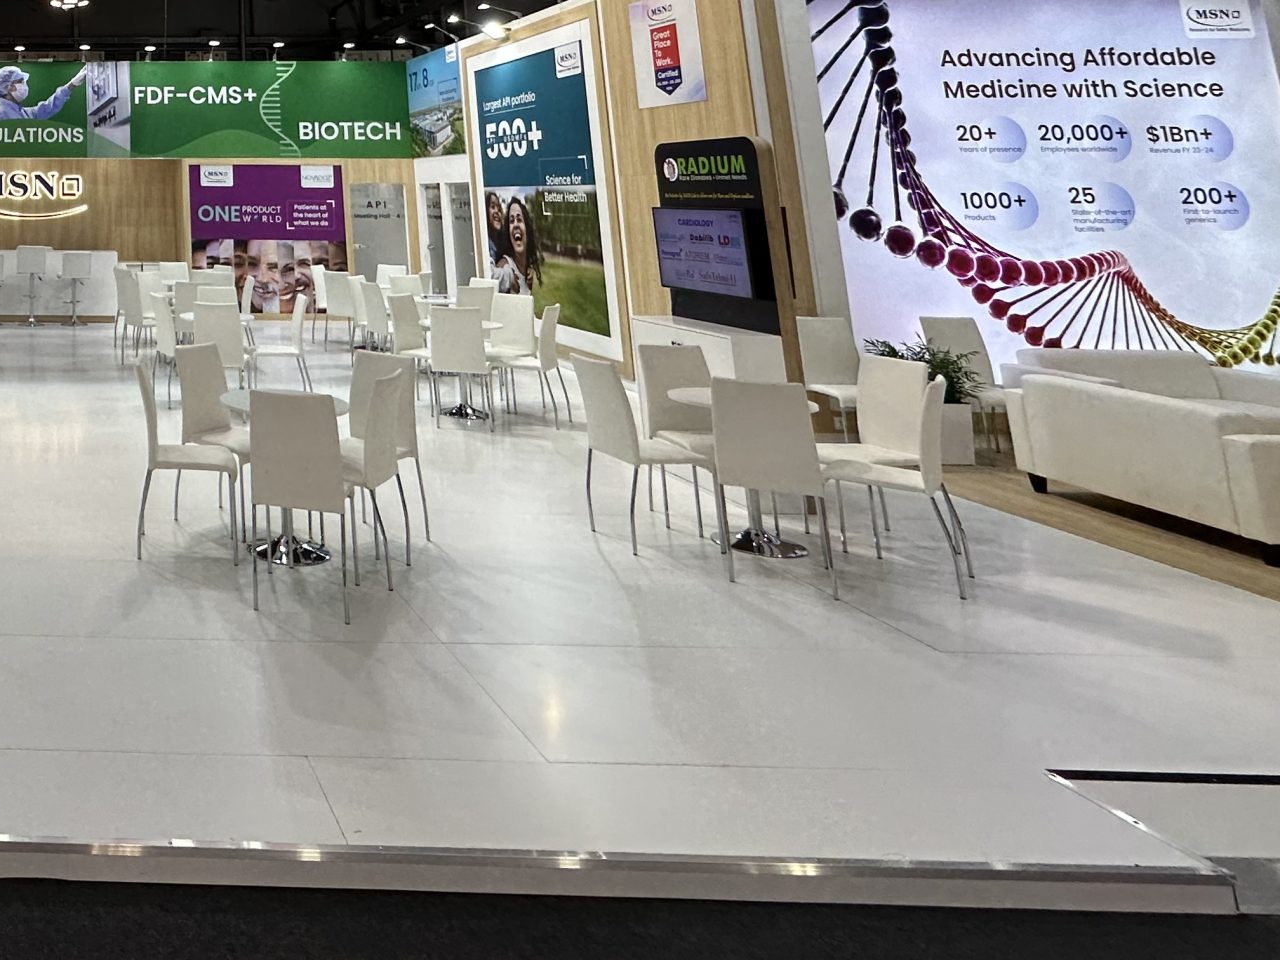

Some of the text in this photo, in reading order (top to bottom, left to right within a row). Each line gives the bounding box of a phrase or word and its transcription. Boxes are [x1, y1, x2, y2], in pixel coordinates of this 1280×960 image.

[651, 4, 668, 17] MSN
[1194, 8, 1230, 20] MSN
[652, 31, 671, 41] Great
[654, 40, 672, 50] Place
[655, 49, 662, 57] To
[940, 47, 1216, 72] Advancing Affordable
[134, 86, 257, 105] FDF-CMS+
[943, 78, 1224, 98] Medicine with Science
[483, 91, 536, 113] Largest API portfolio
[298, 121, 401, 141] BIOTECH
[486, 118, 543, 159] 500+
[956, 124, 997, 141] 20+
[1037, 124, 1128, 144] 20,000+
[1146, 125, 1212, 144] $1Bn+
[1040, 146, 1080, 154] Employees
[677, 155, 746, 175] RADIUM
[545, 173, 582, 185] Science for
[544, 191, 588, 203] Better Health
[960, 192, 1026, 209] 1000+
[1068, 186, 1095, 204] 25
[1179, 187, 1237, 204] 200+
[198, 205, 240, 222] ONE
[242, 205, 282, 214] PRODUCT
[1073, 217, 1128, 226] manufacturing
